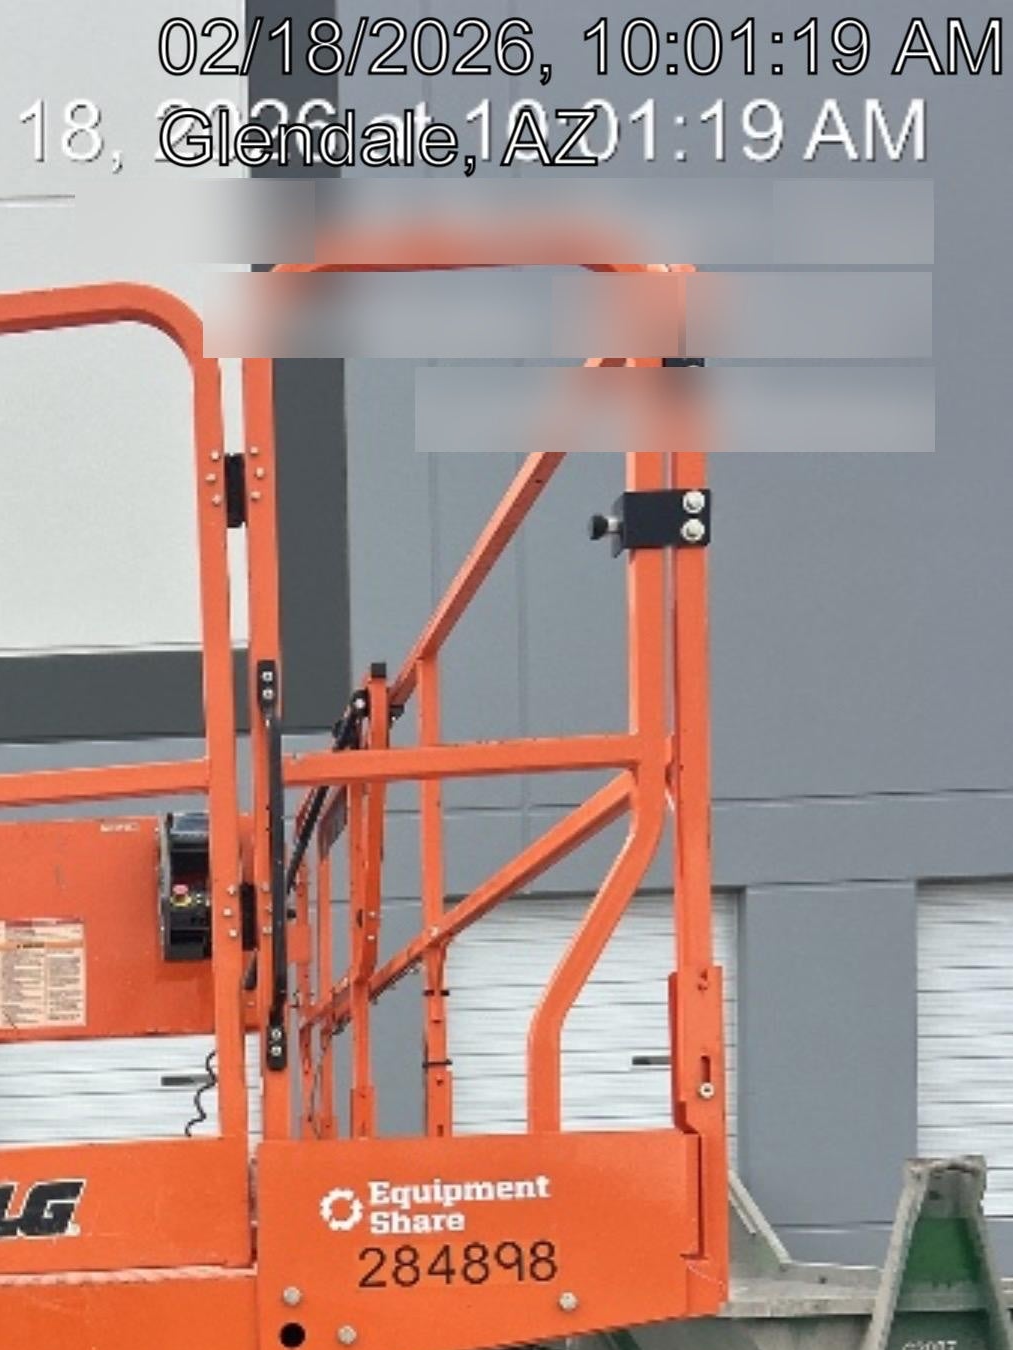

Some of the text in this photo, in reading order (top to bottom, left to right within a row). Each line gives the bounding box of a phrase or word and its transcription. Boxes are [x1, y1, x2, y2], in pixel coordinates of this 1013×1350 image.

[368, 1175, 551, 1209] Equipment
[369, 1210, 466, 1235] Share
[358, 1240, 557, 1288] 284898
